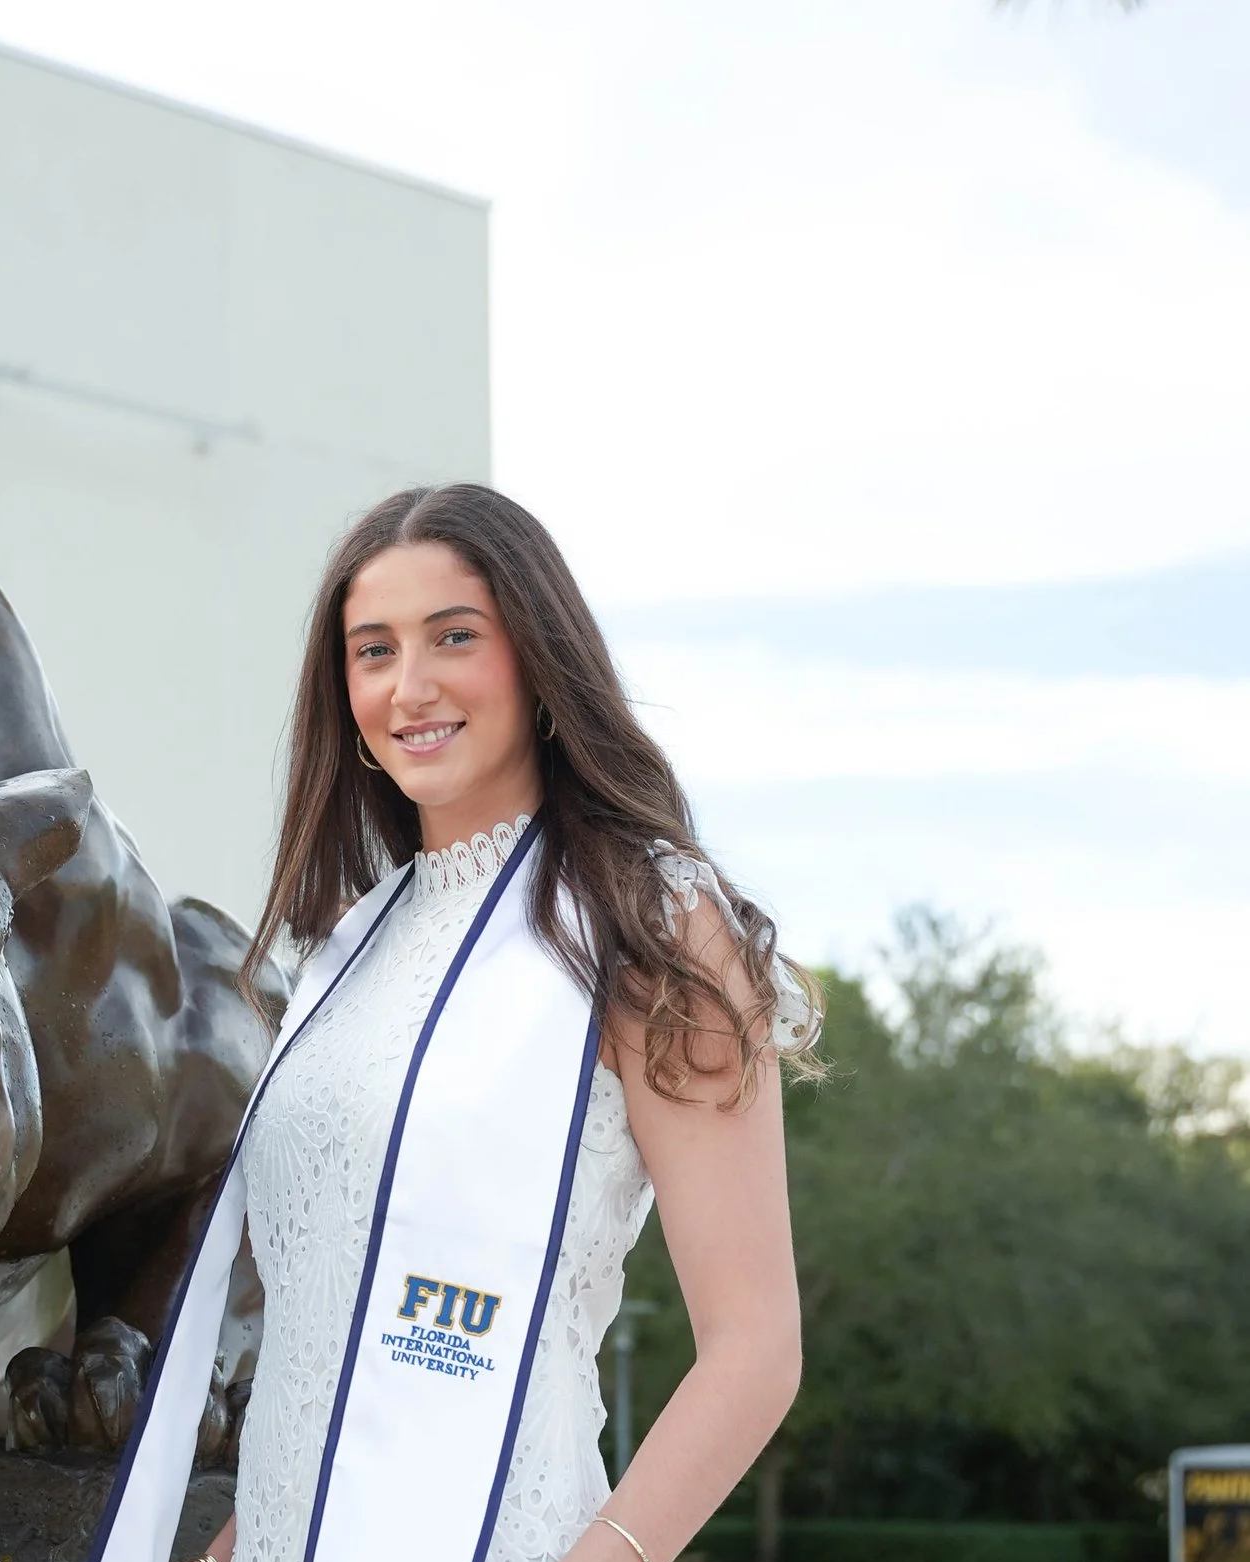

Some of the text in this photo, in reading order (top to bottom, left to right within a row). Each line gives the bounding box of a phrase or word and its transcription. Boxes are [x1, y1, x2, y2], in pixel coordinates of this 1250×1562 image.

[397, 1273, 502, 1337] FIU
[381, 1333, 495, 1371] INTERNATIONAL
[410, 1325, 471, 1350] FLORIDA
[391, 1350, 479, 1381] UNIVERSITY
